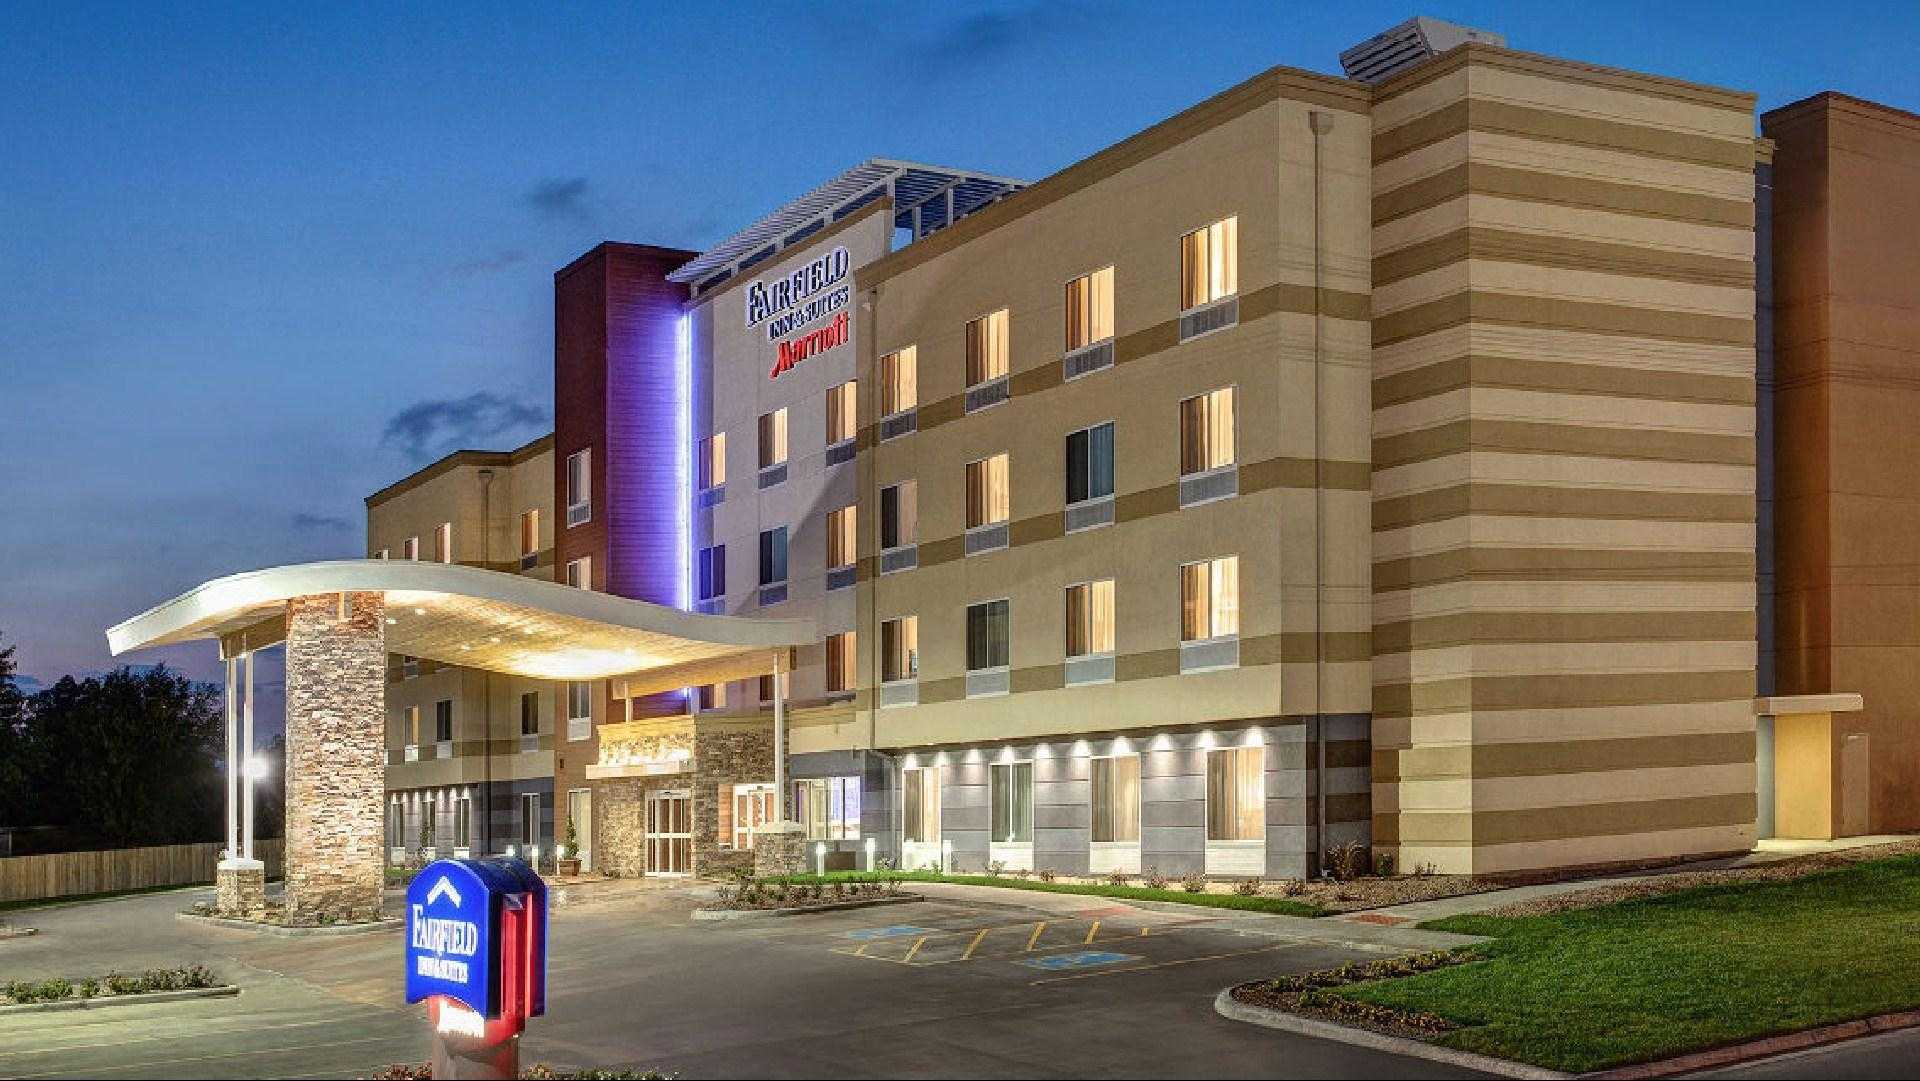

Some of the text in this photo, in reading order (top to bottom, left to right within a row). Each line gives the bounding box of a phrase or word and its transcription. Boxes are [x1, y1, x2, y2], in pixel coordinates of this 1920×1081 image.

[745, 246, 850, 329] FAIRFIELD
[769, 311, 850, 380] Marriott
[412, 903, 478, 956] FAIRFIELD
